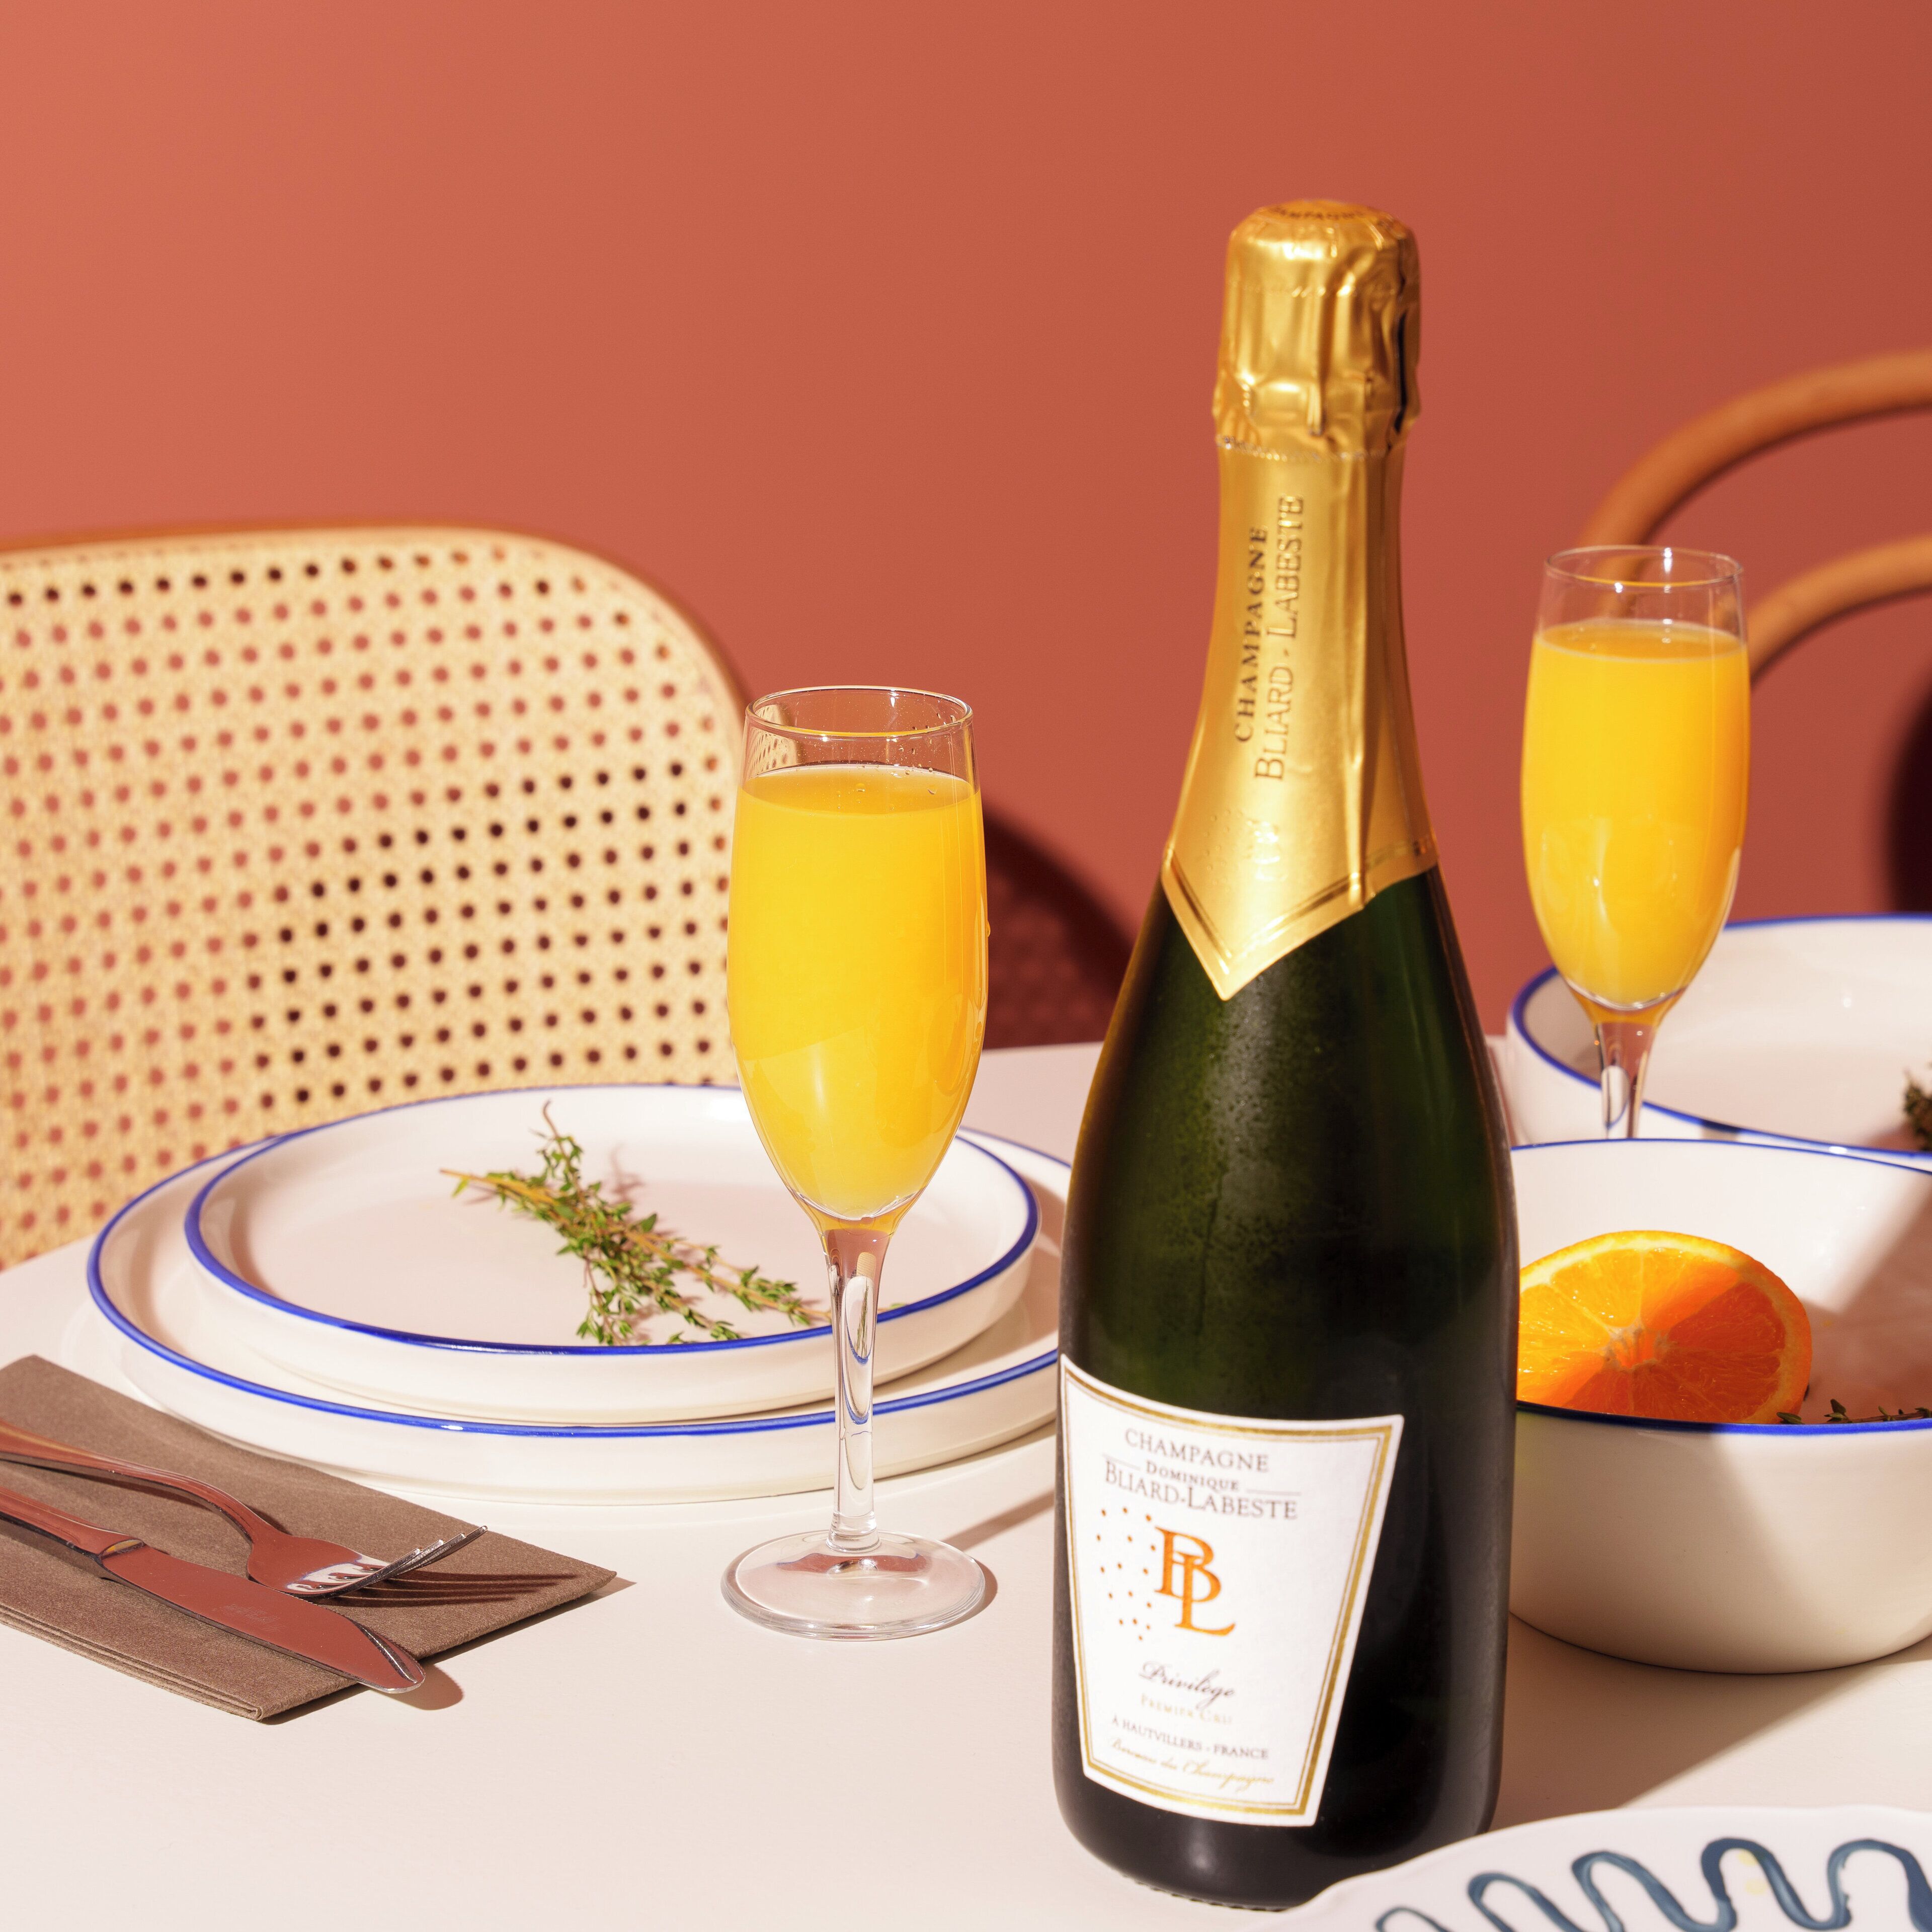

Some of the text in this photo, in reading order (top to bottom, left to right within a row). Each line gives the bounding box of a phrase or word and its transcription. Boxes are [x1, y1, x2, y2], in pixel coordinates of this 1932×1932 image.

[1266, 494, 1304, 639] LABESTE
[1234, 525, 1268, 743] CHAMPAGNE
[1255, 665, 1294, 781] BLIARD
[1124, 1427, 1269, 1473] CHAMPAGNE
[1145, 1460, 1240, 1493] DOMINIQUE
[1105, 1460, 1298, 1520] BLIARD-LABESTE
[1122, 1719, 1202, 1751] HAUTVILLERS
[1214, 1743, 1269, 1760] FRANCE
